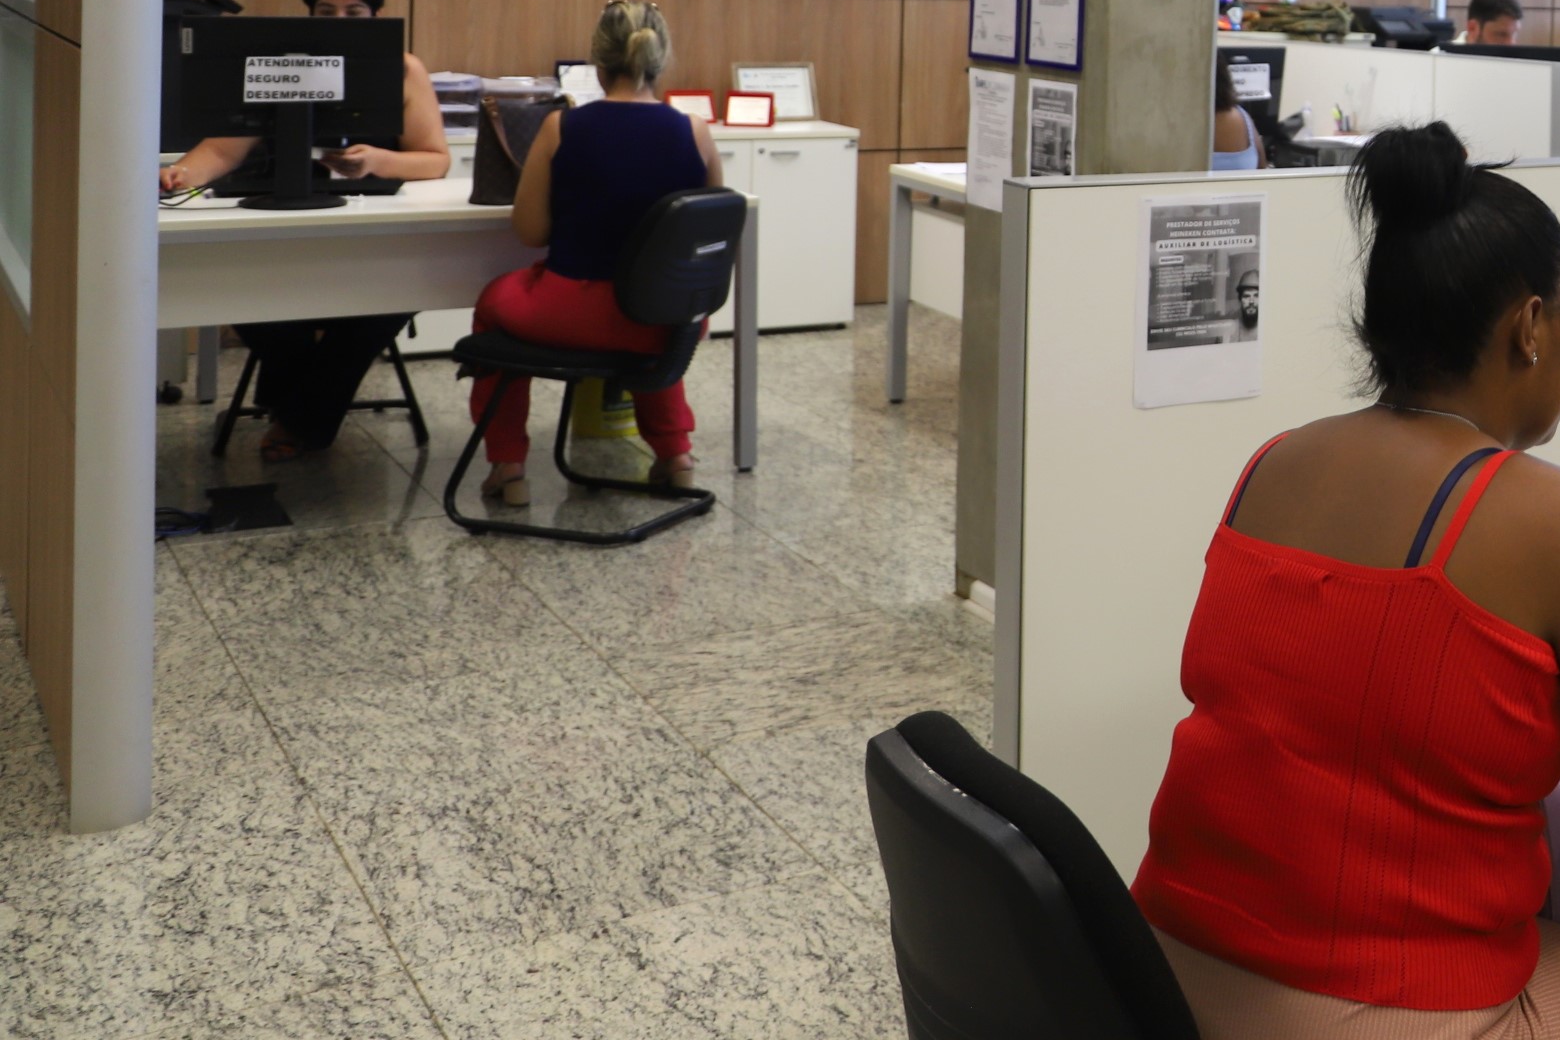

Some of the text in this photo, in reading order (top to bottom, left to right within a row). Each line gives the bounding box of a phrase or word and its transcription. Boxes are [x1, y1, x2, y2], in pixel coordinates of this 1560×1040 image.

[247, 59, 340, 68] ATENDIMENTO
[247, 75, 300, 83] SEGURO
[246, 91, 335, 99] DESEMPREGO
[1166, 218, 1240, 228] PRESTADOR DE SERVIÇOS
[1169, 229, 1201, 238] HEINEKEN
[1159, 241, 1196, 249] AUXILIAR
[1213, 237, 1253, 246] LOGÍSTICA
